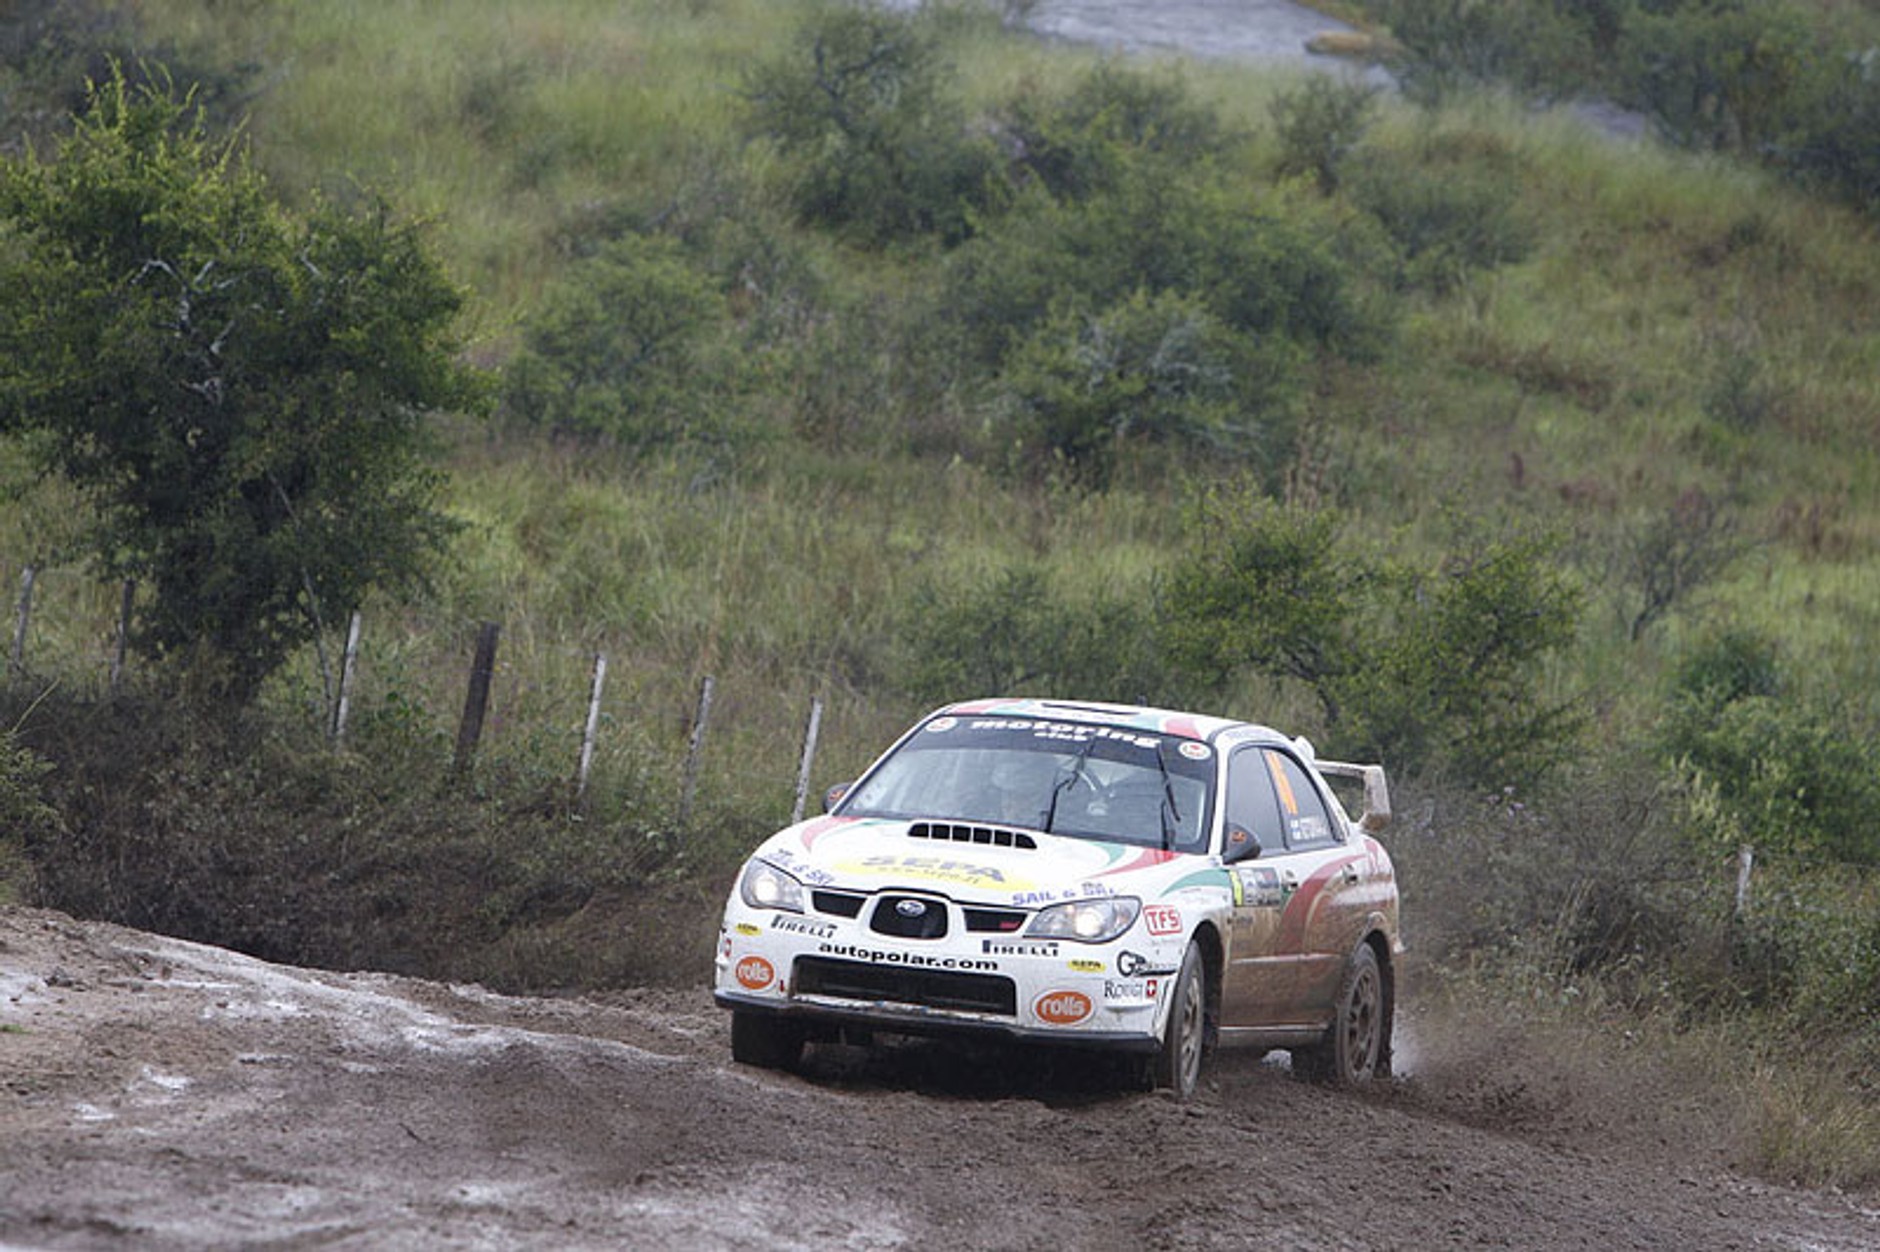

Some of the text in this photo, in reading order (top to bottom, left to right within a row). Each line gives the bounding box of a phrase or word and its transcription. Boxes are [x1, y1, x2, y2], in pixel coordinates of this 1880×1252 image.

[970, 719, 1162, 749] motoring
[1012, 890, 1056, 907] SAIL
[771, 914, 838, 939] PIRELLI
[1146, 908, 1180, 930] TFS
[818, 942, 999, 971] autopolar.com
[982, 939, 1059, 957] PIRELLI
[738, 961, 769, 982] rolls
[1041, 994, 1086, 1018] rolls
